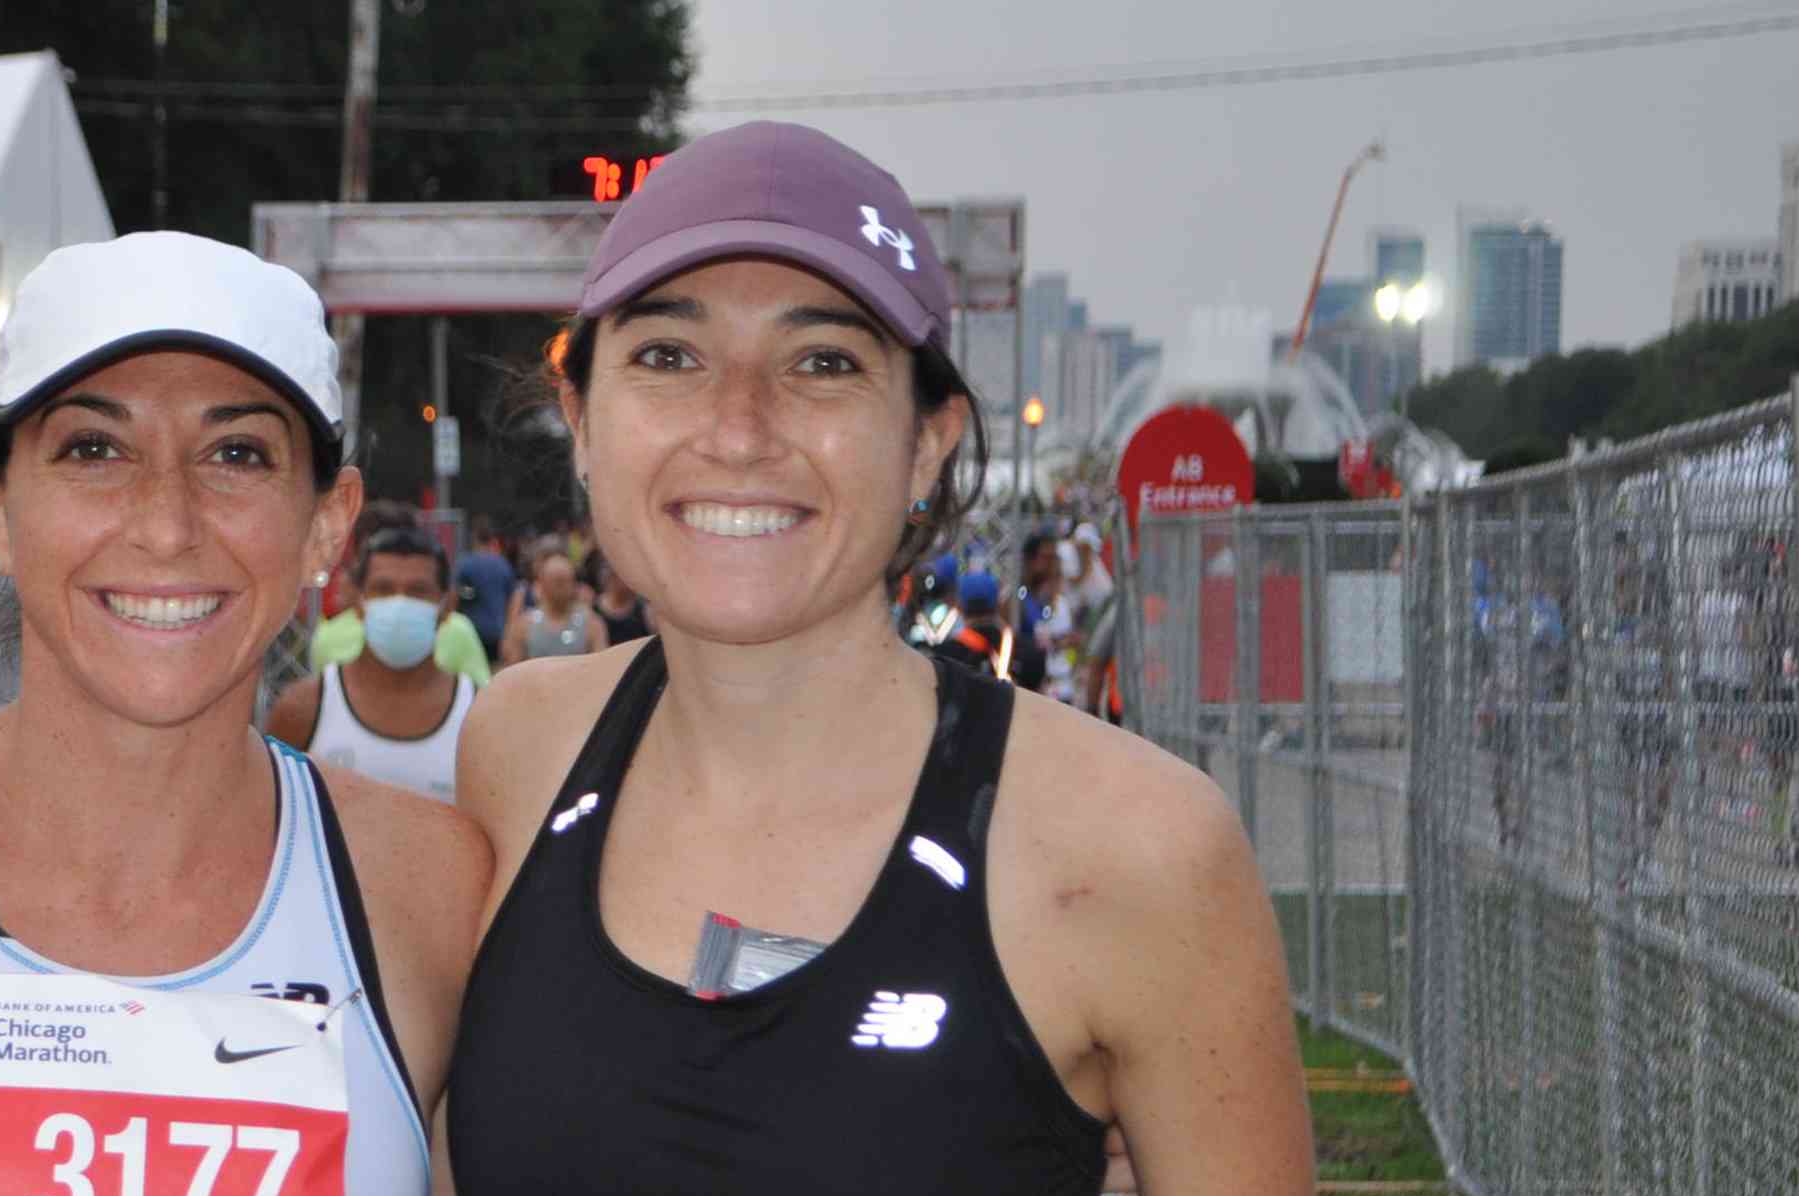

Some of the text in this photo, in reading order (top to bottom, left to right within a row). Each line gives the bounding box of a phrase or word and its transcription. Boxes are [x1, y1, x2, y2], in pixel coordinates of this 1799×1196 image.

[582, 156, 664, 202] 7:1
[1171, 454, 1204, 480] AB
[1140, 482, 1236, 508] Entrance
[34, 1002, 51, 1012] OF
[55, 1003, 115, 1014] AMERICA
